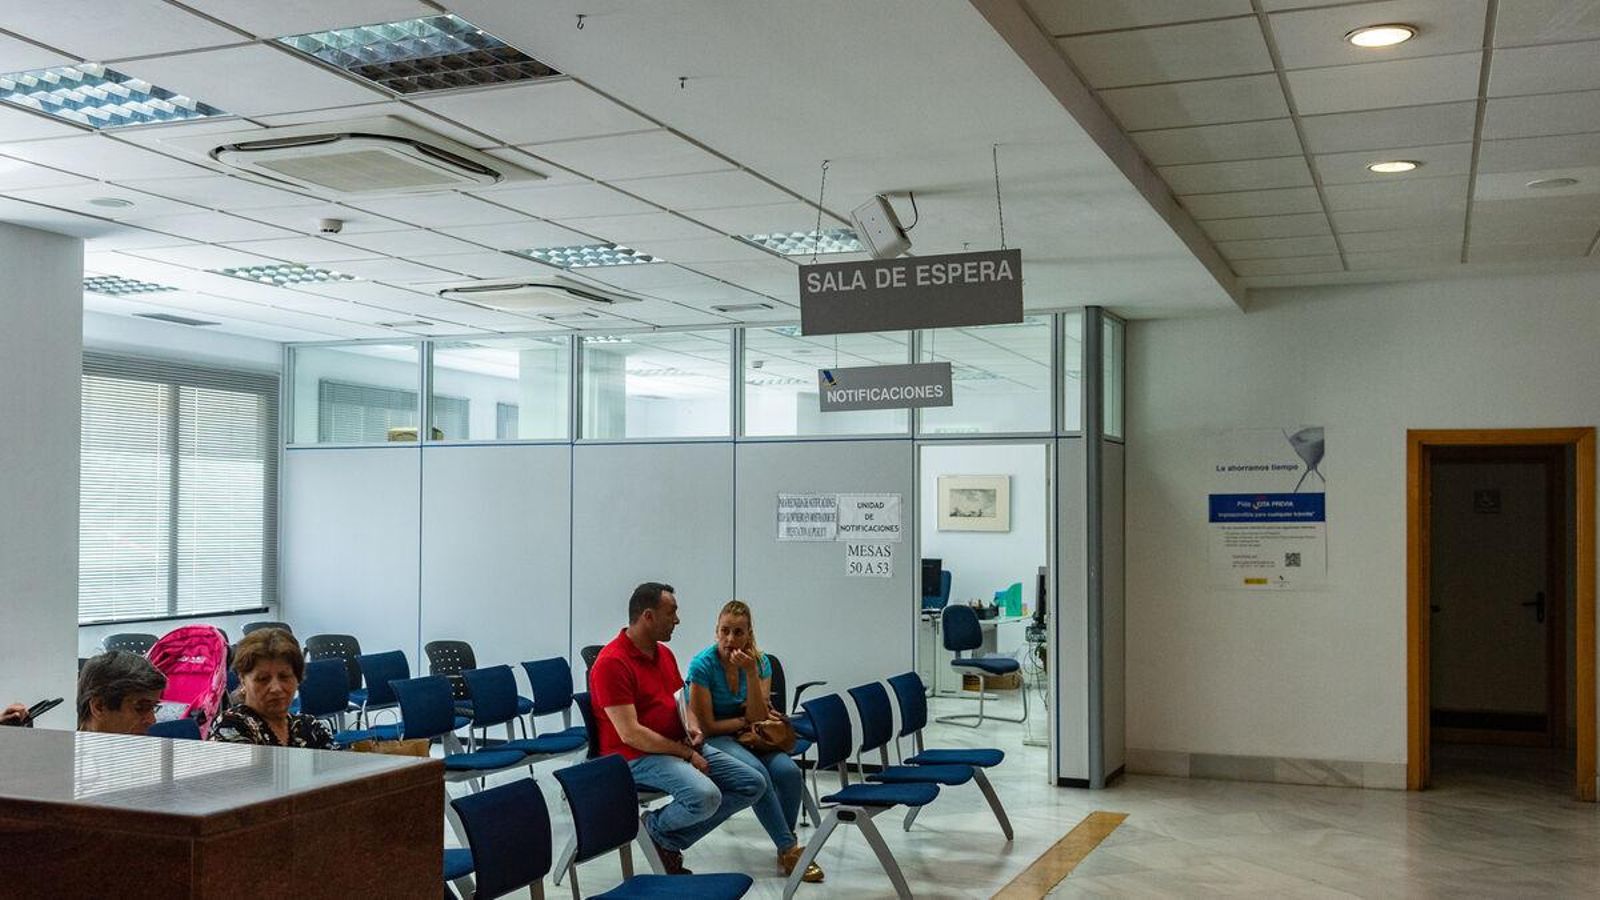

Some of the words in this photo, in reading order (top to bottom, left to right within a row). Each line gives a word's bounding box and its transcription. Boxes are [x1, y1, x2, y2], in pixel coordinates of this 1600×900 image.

[807, 270, 866, 293] SALA
[875, 266, 907, 289] DE
[916, 260, 1013, 286] ESPERA
[827, 384, 944, 403] NOTIFICACIONES
[1228, 464, 1269, 472] ahorramos
[1271, 464, 1298, 472] tiempo
[840, 525, 900, 533] NOTIFICACIONES
[848, 545, 891, 557] MESAS
[849, 561, 863, 575] 50
[864, 562, 874, 575] A
[876, 561, 890, 575] 53
